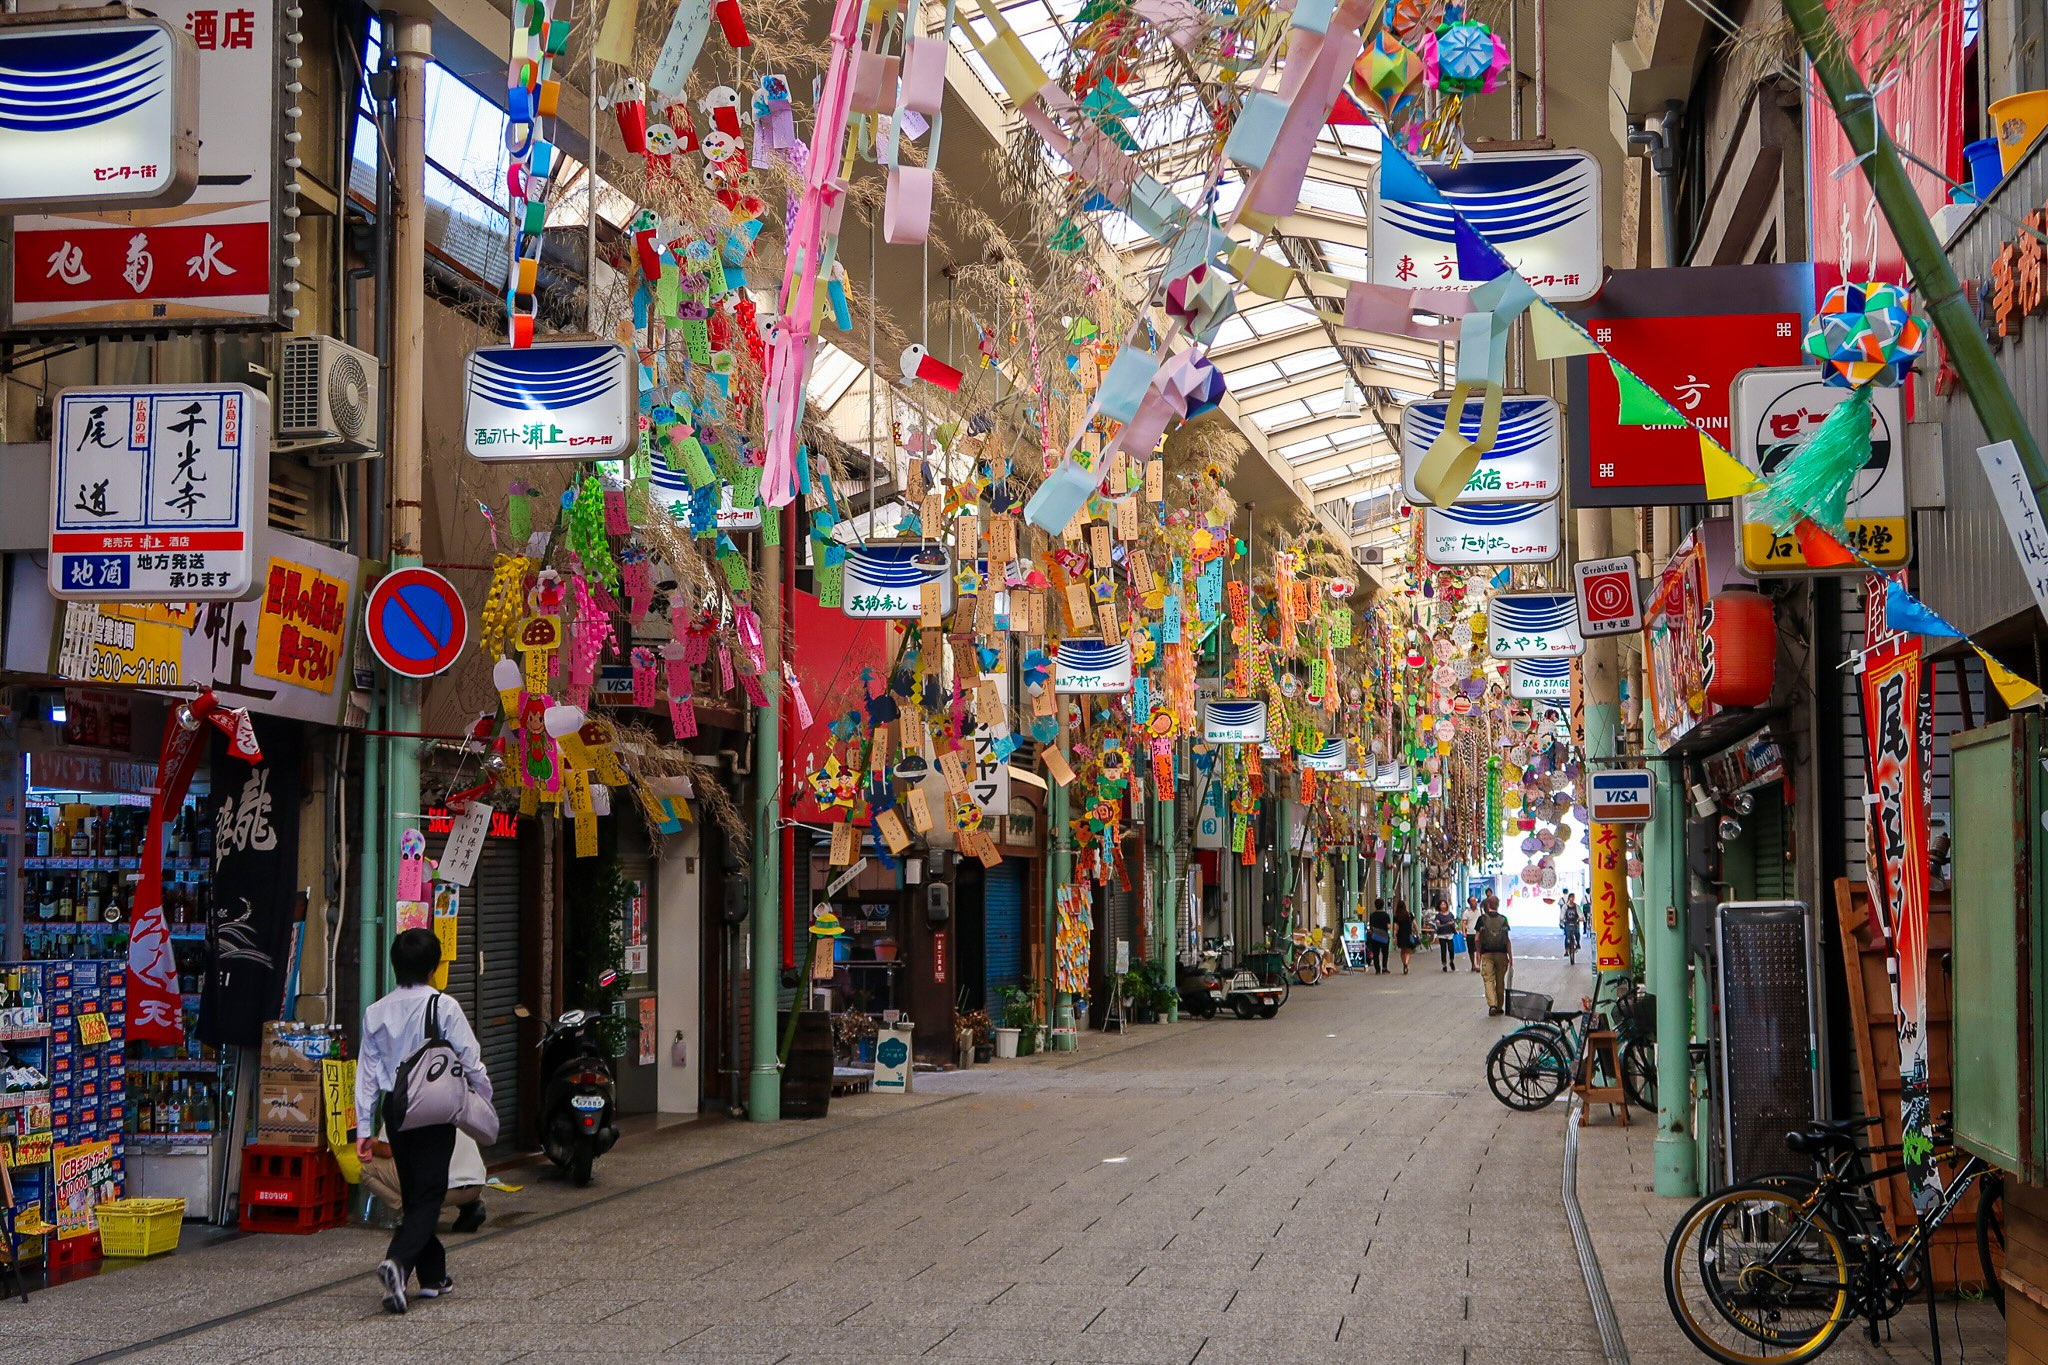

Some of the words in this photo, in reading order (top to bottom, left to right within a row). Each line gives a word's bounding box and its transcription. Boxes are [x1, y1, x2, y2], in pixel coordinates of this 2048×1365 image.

[93, 165, 157, 181] センター街
[134, 399, 146, 444] 広島の酒
[224, 398, 237, 442] 広島の酒
[473, 428, 520, 446] 酒のデパート
[522, 421, 567, 449] 浦上
[569, 435, 612, 446] センター街
[74, 405, 124, 518] 尾道
[165, 401, 208, 519] 千光寺
[1505, 480, 1547, 489] センター街
[716, 512, 754, 520] センター街
[102, 537, 133, 548] 発売元
[169, 536, 190, 547] 酒店
[1461, 532, 1511, 554] たかはら
[137, 553, 205, 569] 地方発送
[1582, 565, 1607, 575] Credit
[1608, 562, 1628, 571] Card
[70, 559, 122, 586] 地酒
[169, 571, 231, 587] 承ります
[850, 594, 909, 611] 天狗寿し
[1593, 619, 1630, 630] 日専連
[1495, 635, 1548, 651] みやち
[606, 677, 633, 692] VISA
[1067, 675, 1101, 687] アオヤマ
[1523, 679, 1540, 688] BAG
[1543, 679, 1569, 688] STAGE
[1605, 790, 1638, 802] VISA
[428, 806, 456, 833] SAL
[490, 811, 519, 838] SALE
[1599, 881, 1623, 945] うどん
